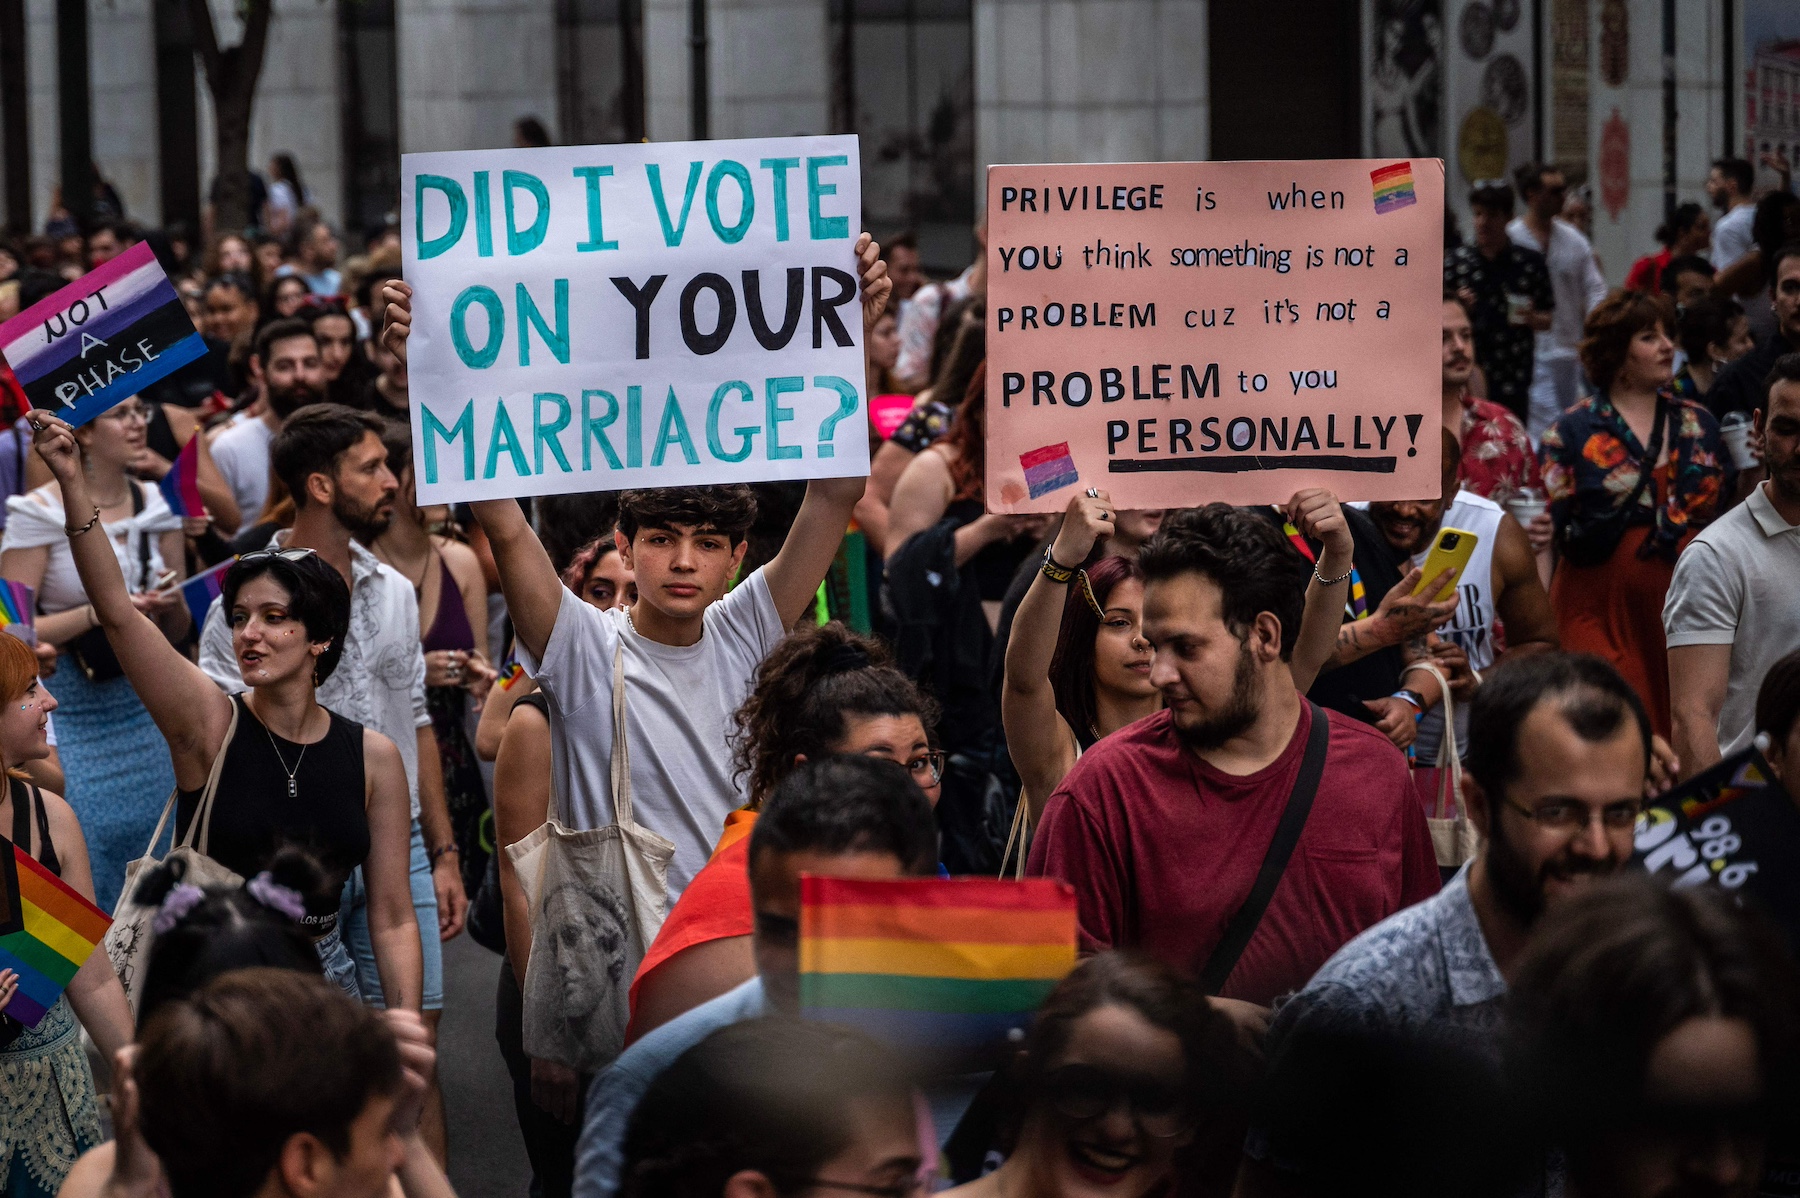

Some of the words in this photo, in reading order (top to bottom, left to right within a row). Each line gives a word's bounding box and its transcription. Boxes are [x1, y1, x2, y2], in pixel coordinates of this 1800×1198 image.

[415, 169, 550, 260] DID
[573, 165, 618, 252] I
[645, 155, 849, 247] VOTE
[1001, 184, 1164, 212] PRIVILEGE
[1196, 187, 1216, 211] is
[1267, 181, 1344, 210] when
[998, 245, 1063, 272] YOU
[1082, 239, 1152, 269] think
[1170, 239, 1292, 273] something
[1306, 245, 1324, 270] is
[1335, 245, 1375, 267] not
[1394, 248, 1409, 267] a
[44, 285, 108, 343] NOT
[450, 278, 570, 369] ON
[609, 266, 857, 359] YOUR
[998, 302, 1156, 332] PROBLEM
[1184, 308, 1235, 328] cuz
[1263, 299, 1299, 324] it's
[1316, 299, 1357, 322] not
[1376, 300, 1391, 320] a
[80, 332, 108, 359] A
[54, 338, 160, 410] PHASE
[1002, 363, 1221, 408] PROBLEM
[1237, 370, 1268, 393] to
[1289, 368, 1338, 397] you
[421, 375, 859, 484] MARRIAGE?
[1106, 413, 1424, 459] PERSONALLY!
